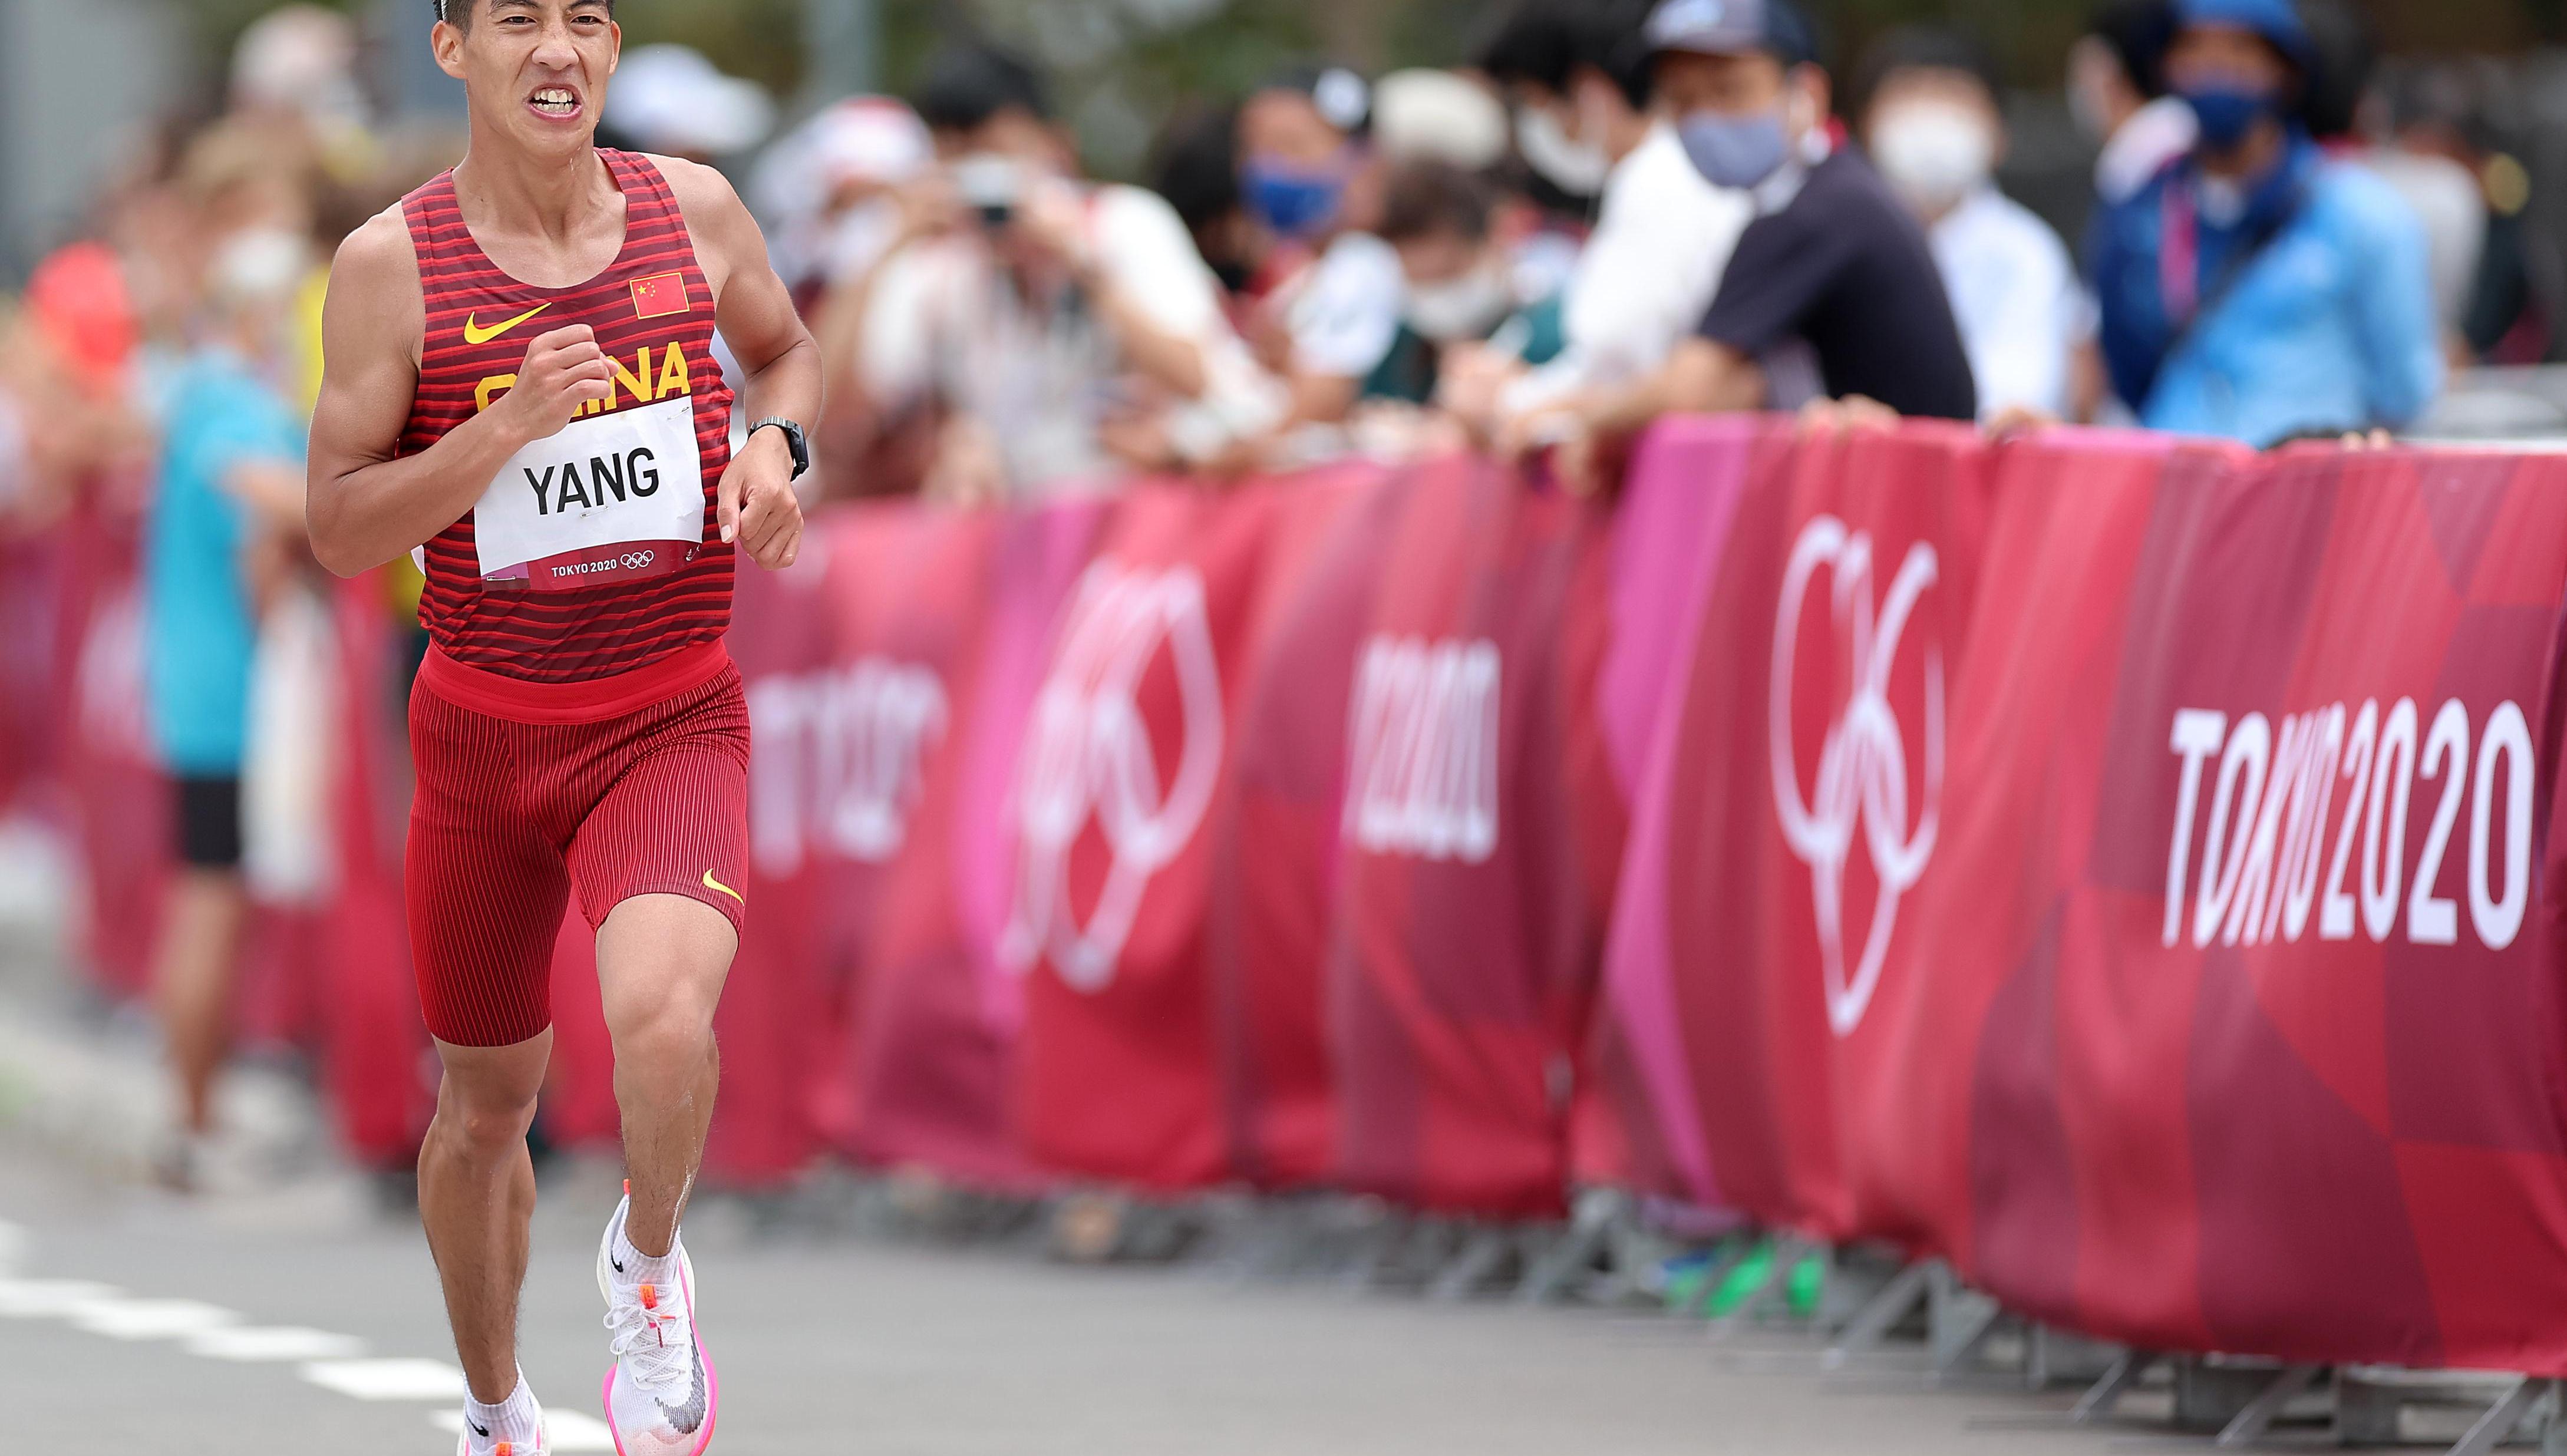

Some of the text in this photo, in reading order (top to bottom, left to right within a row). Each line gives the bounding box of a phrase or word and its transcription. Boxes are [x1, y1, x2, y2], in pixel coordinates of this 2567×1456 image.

[523, 447, 659, 516] YANG
[551, 559, 617, 577] TOKYO 2020
